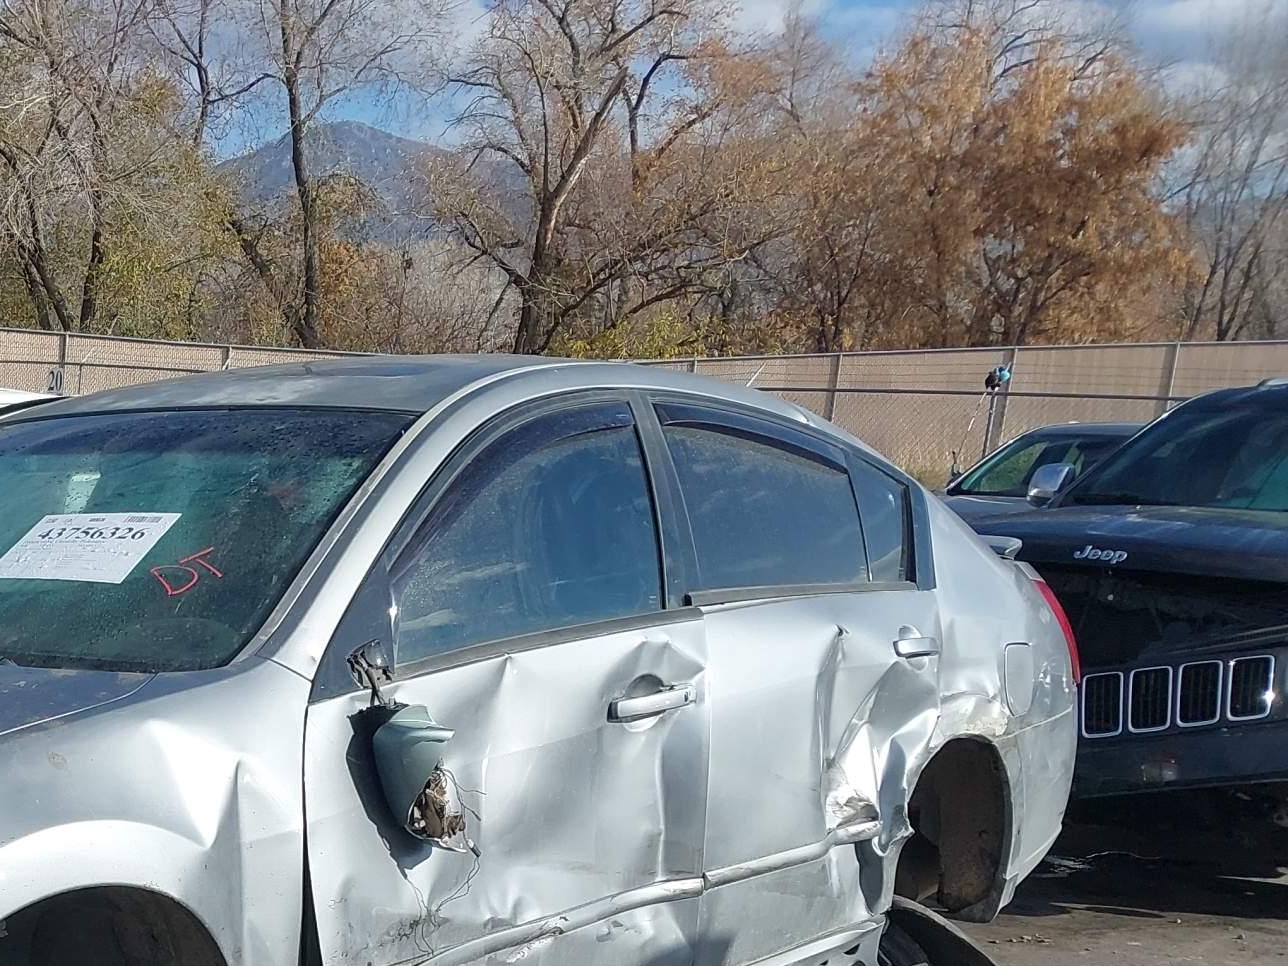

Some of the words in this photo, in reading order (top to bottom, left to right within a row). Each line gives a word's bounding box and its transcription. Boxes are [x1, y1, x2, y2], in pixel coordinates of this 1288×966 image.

[47, 370, 63, 391] 20
[38, 526, 148, 541] 43756326
[1073, 545, 1128, 564] Jeep
[151, 546, 223, 597] DT
